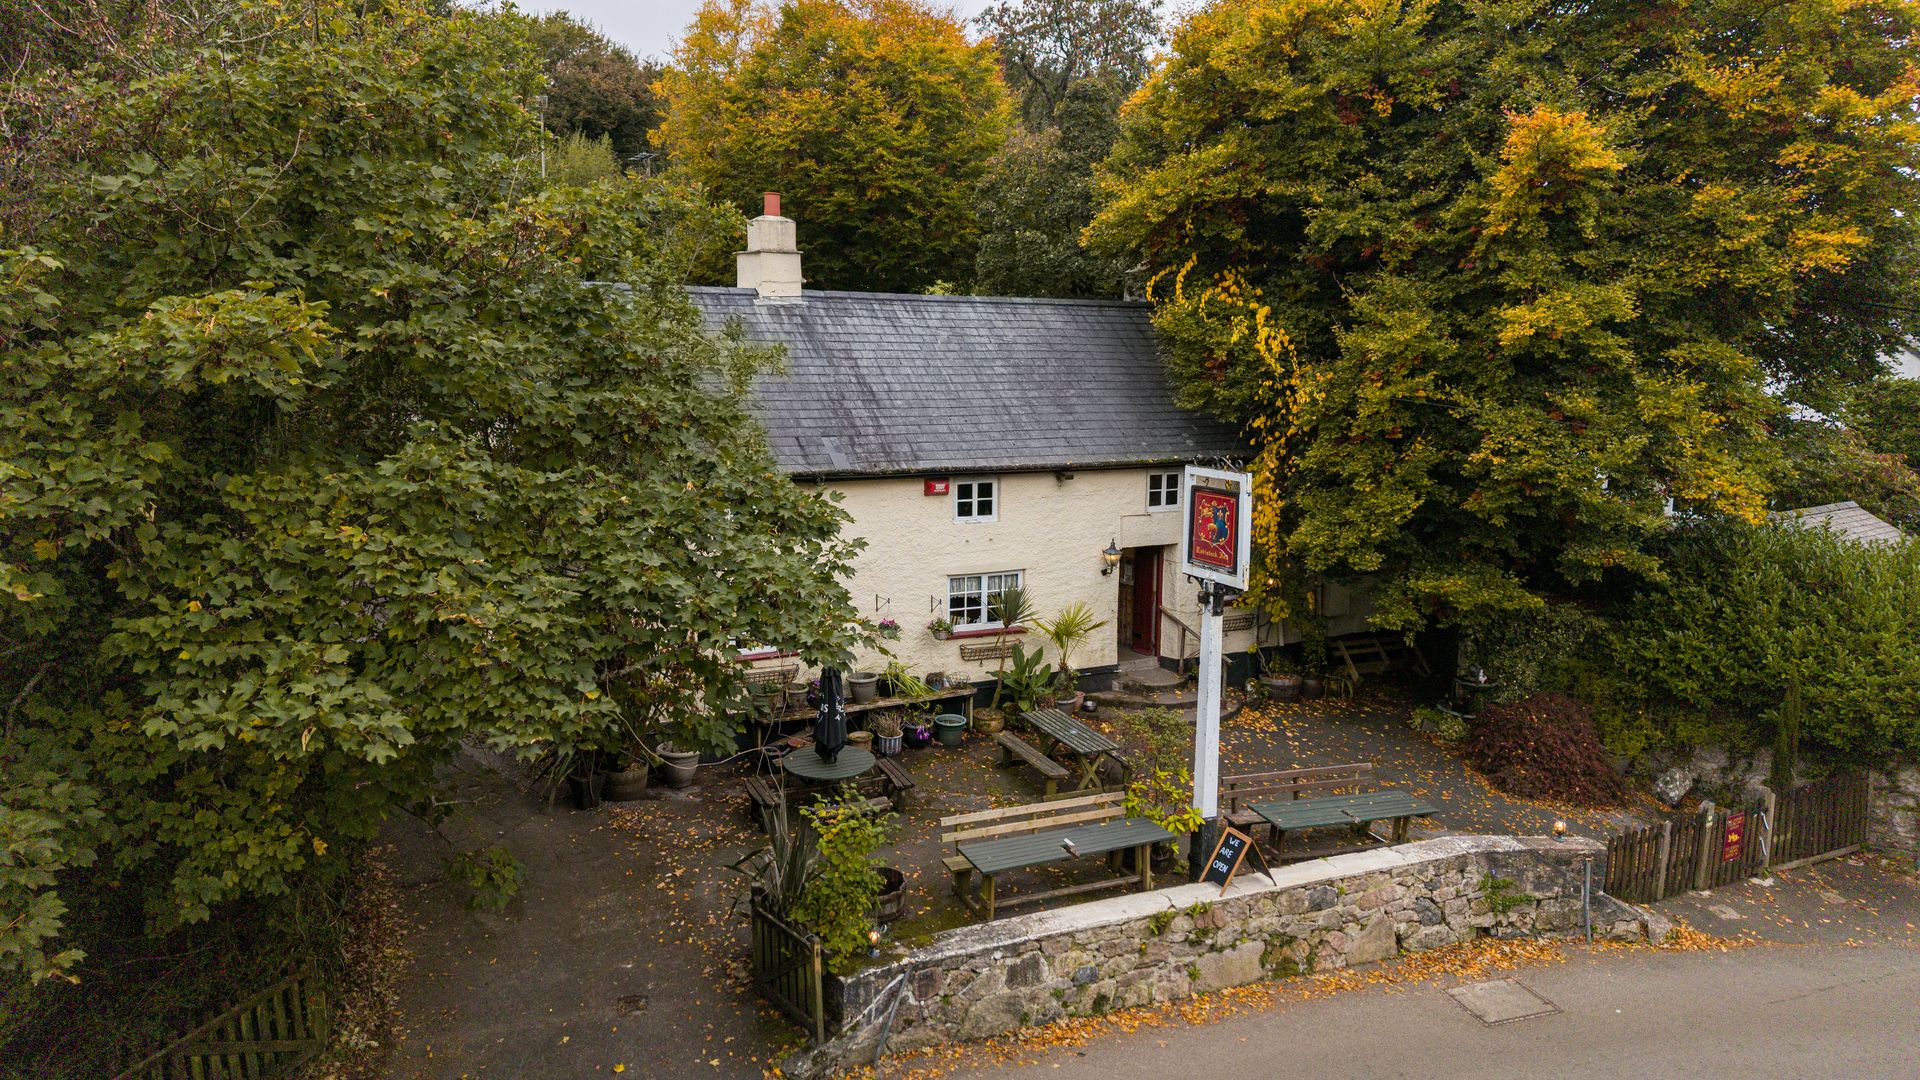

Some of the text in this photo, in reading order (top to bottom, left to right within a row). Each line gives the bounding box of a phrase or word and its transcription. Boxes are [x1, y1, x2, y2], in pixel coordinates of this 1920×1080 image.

[1229, 836, 1241, 847] WE
[1219, 846, 1234, 859] ARE
[1212, 860, 1229, 874] OPEN
